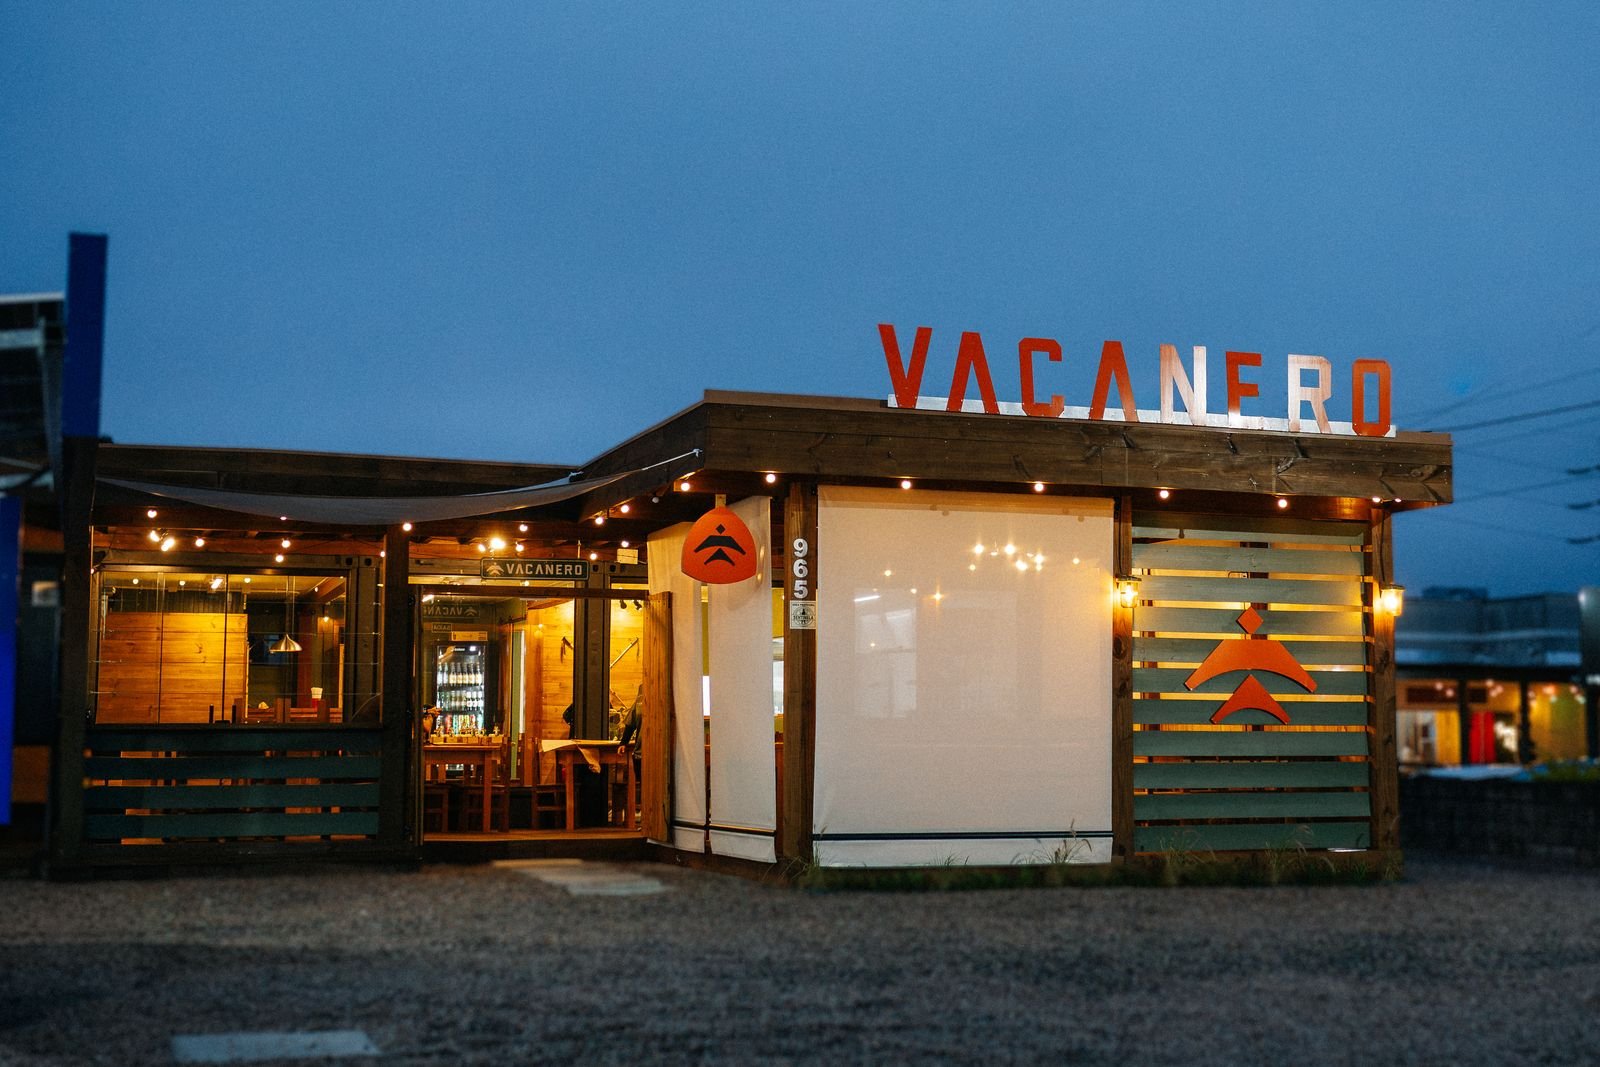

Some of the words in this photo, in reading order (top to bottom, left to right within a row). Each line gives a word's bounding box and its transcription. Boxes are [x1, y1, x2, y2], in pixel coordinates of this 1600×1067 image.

[878, 323, 1392, 437] VACANERO
[506, 564, 582, 575] VACANERO
[793, 538, 808, 599] 965
